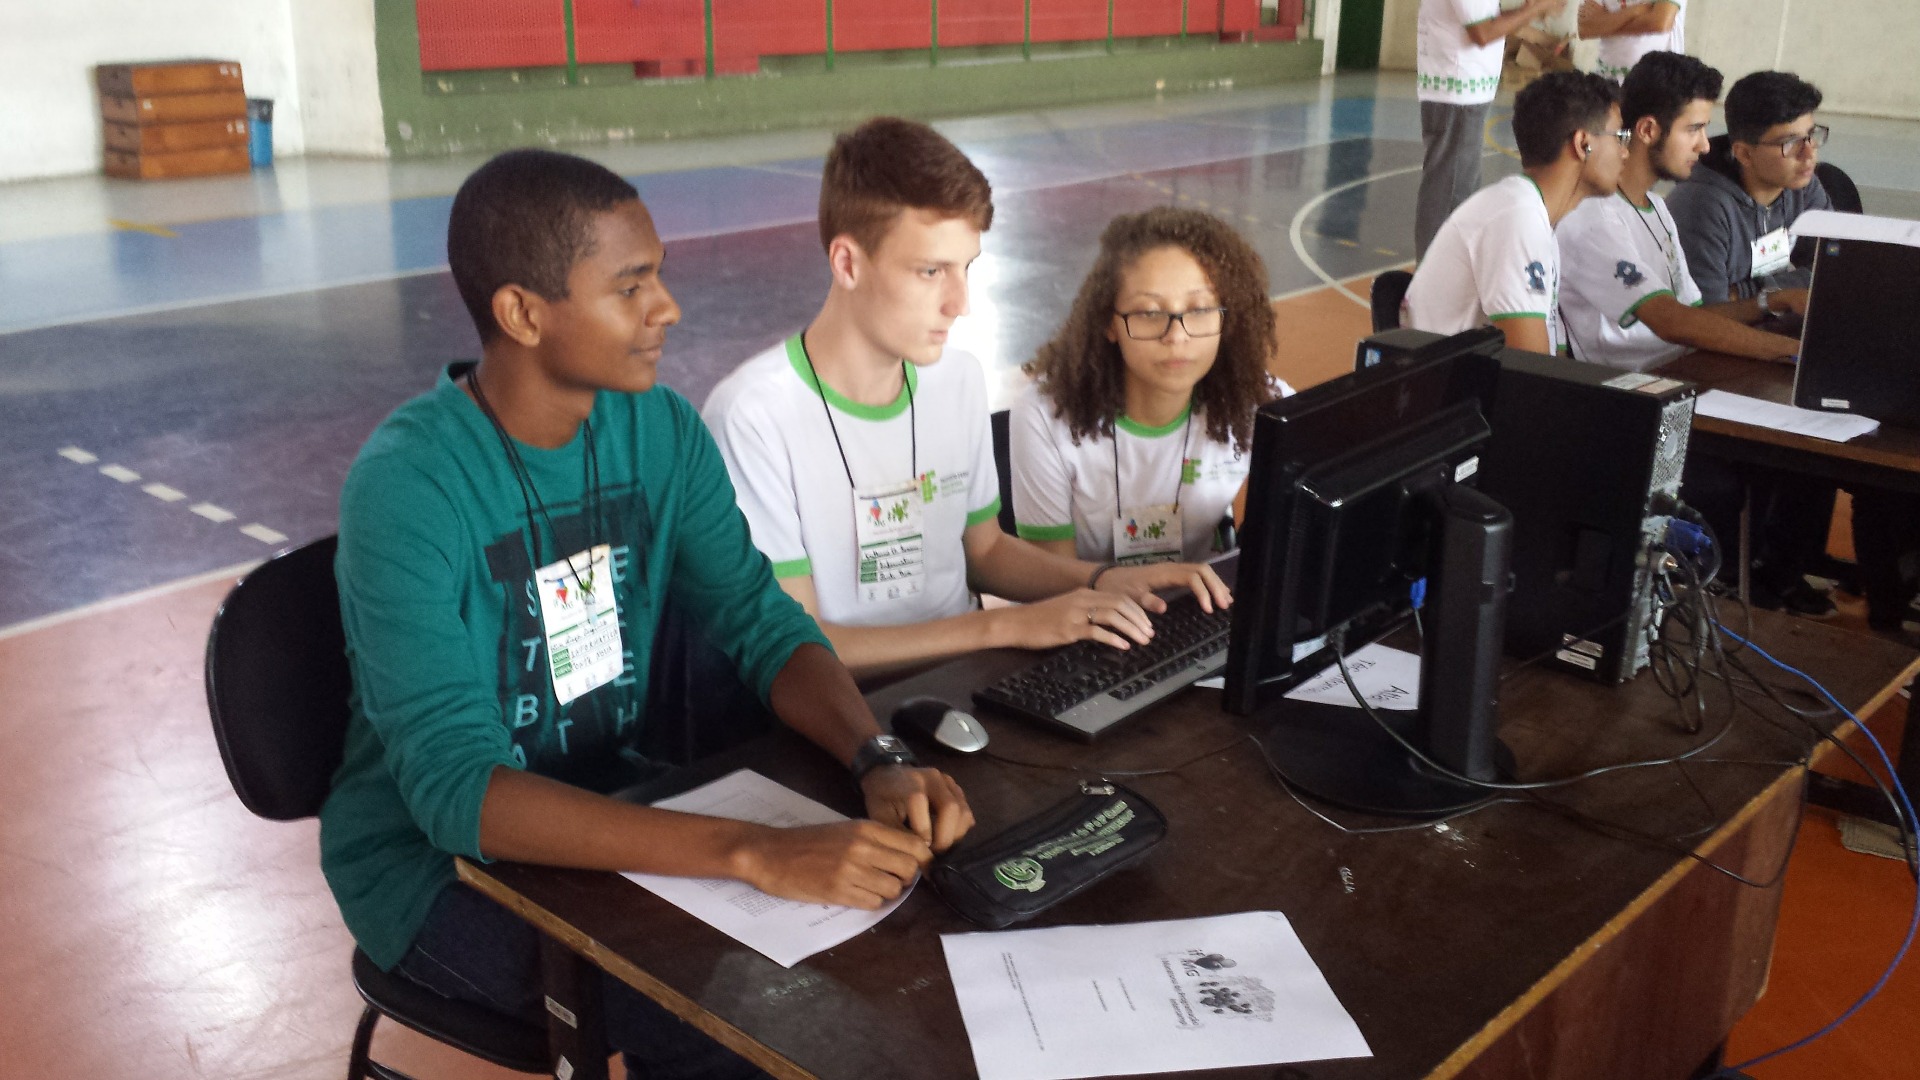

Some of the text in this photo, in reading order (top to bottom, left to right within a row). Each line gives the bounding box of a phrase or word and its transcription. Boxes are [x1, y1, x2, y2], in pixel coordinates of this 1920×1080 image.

[526, 579, 538, 618] S
[521, 636, 542, 672] T
[515, 694, 539, 728] B
